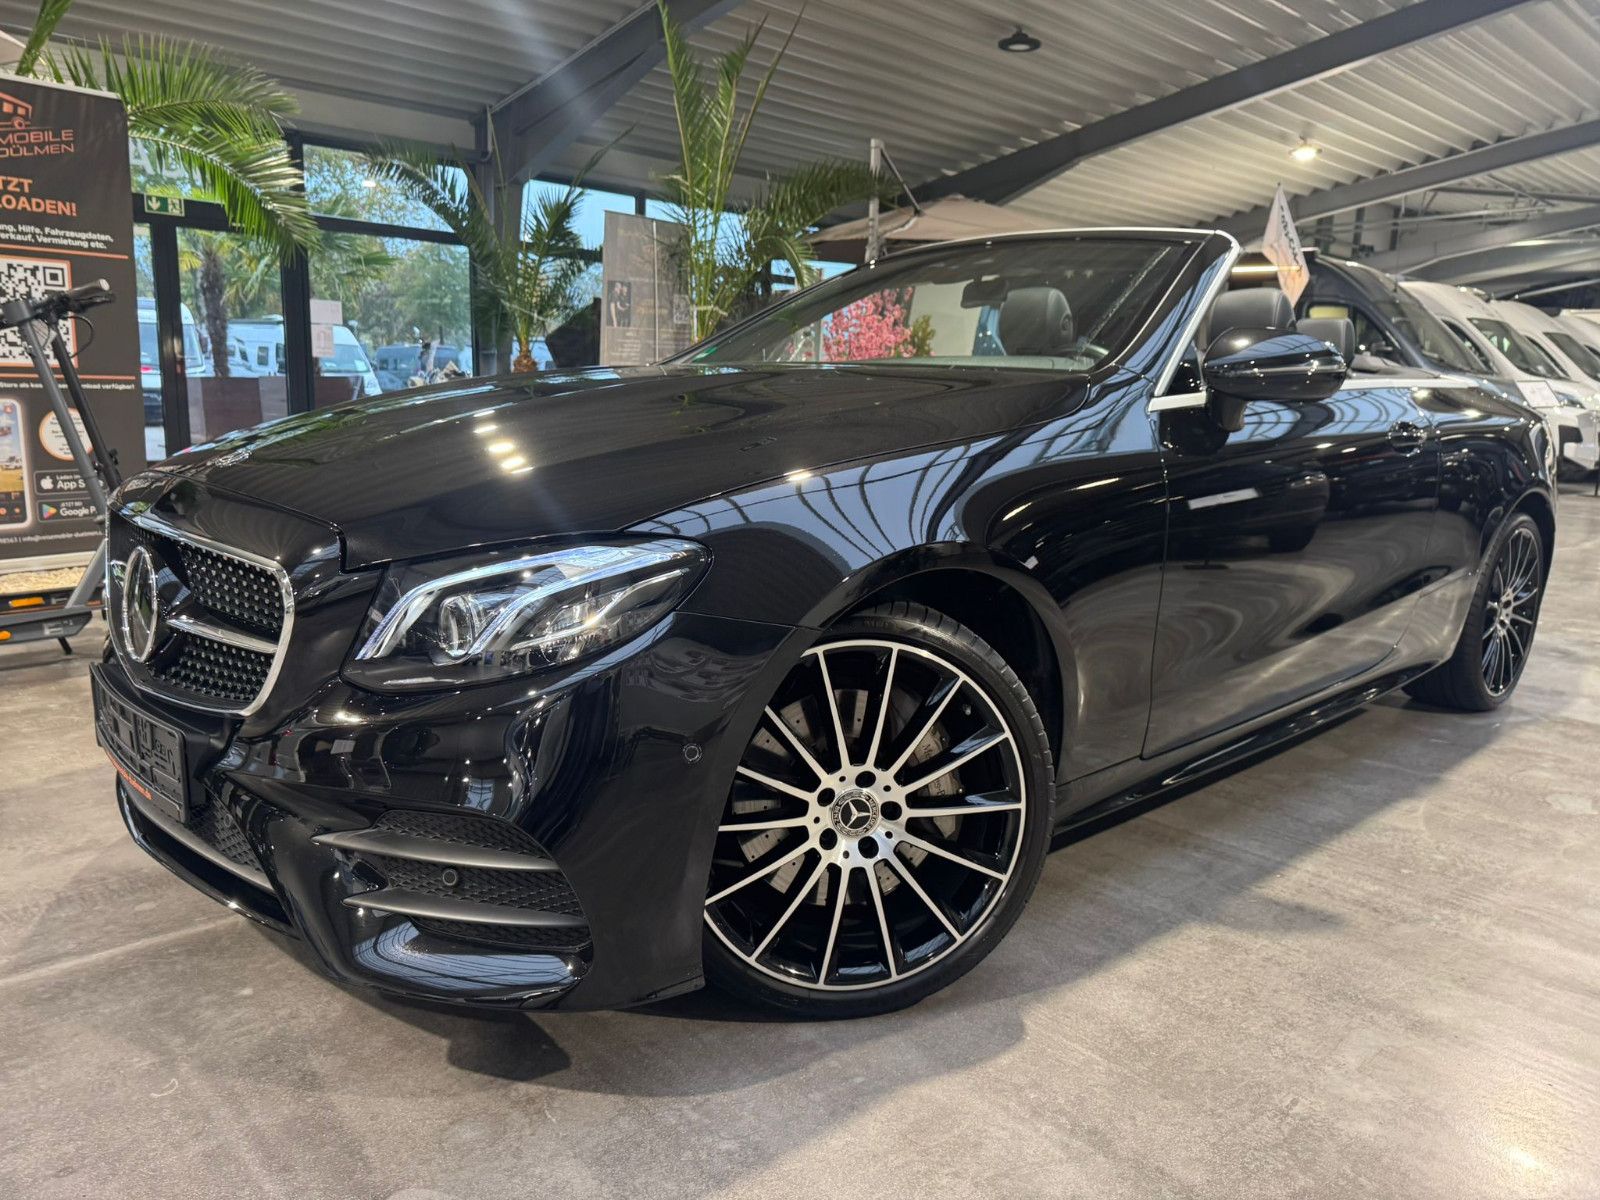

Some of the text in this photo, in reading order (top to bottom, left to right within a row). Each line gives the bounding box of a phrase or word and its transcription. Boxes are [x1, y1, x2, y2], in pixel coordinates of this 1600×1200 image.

[0, 194, 77, 217] OADEN!
[36, 235, 89, 249] Vermietung
[57, 480, 77, 490] App
[60, 507, 90, 517] Google
